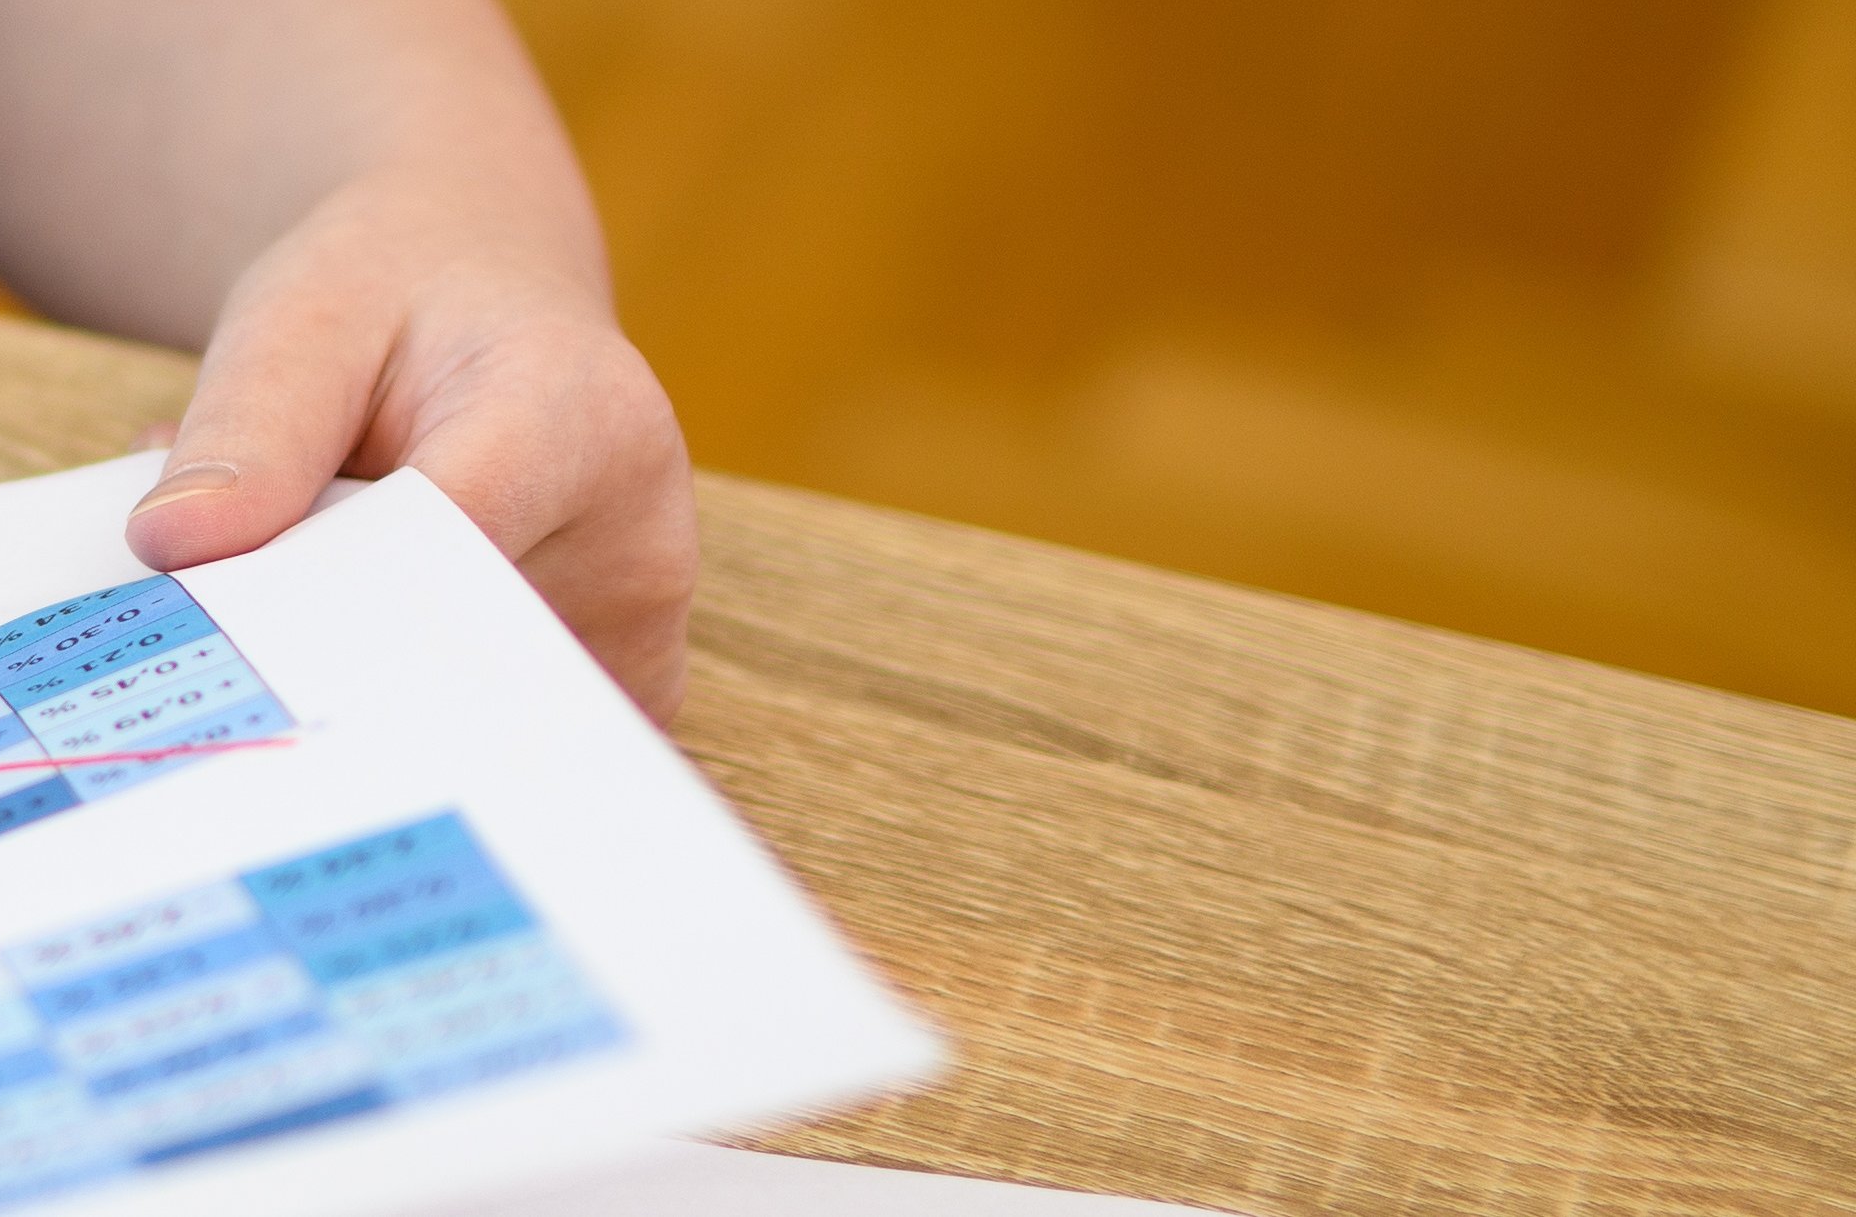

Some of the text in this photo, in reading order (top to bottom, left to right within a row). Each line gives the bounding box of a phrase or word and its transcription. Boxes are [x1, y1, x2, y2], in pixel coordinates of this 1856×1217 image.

[55, 608, 140, 652] 0,30
[6, 653, 44, 672] %
[74, 632, 163, 672] 0,21
[26, 675, 64, 694] %
[89, 660, 178, 700] 0,45
[39, 699, 77, 719] %
[114, 690, 202, 731] 0,49
[62, 730, 100, 749] %
